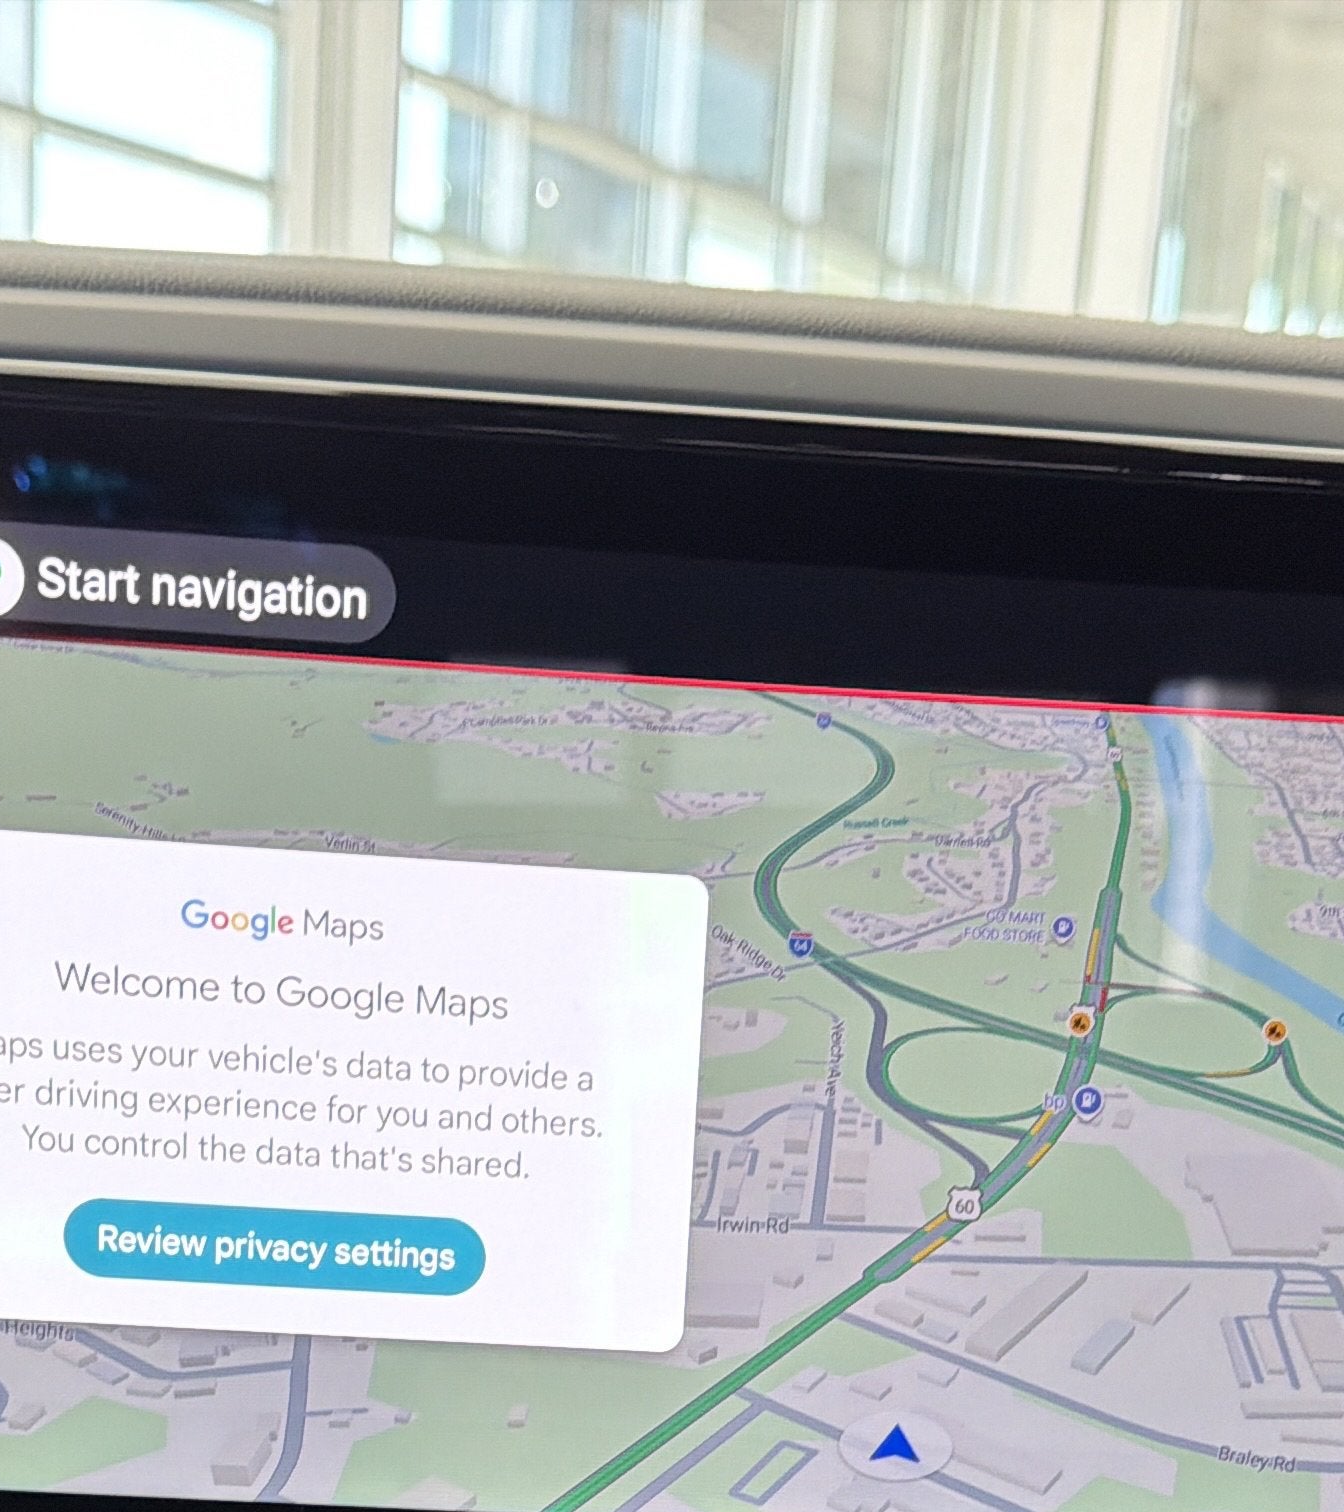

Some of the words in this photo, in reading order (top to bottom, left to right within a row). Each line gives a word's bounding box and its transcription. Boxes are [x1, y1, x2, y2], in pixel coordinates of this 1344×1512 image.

[37, 556, 140, 604] Start
[151, 571, 369, 622] navigation
[94, 802, 139, 833] Serenity
[141, 823, 167, 841] Hills
[181, 898, 294, 942] Google
[304, 908, 384, 947] Maps
[986, 909, 1006, 924] GO
[1008, 910, 1047, 925] MART
[1318, 905, 1341, 919] 9th
[793, 939, 809, 953] 64
[964, 927, 999, 941] FOOD
[1002, 928, 1046, 944] STORE
[711, 924, 735, 944] Oak
[737, 938, 772, 968] Ridge
[770, 965, 785, 982] Dr
[54, 960, 221, 1003] Welcome
[231, 974, 266, 1005] to
[276, 975, 405, 1021] Google
[416, 984, 509, 1026] Maps
[53, 1039, 123, 1064] uses
[131, 1043, 199, 1072] your
[208, 1043, 338, 1078] vehicle's
[346, 1050, 411, 1082] data
[421, 1057, 450, 1084] to
[458, 1060, 568, 1092] provide
[577, 1071, 594, 1092] a
[35, 1077, 139, 1119] driving
[148, 1089, 317, 1123] experience
[326, 1094, 368, 1125] for
[376, 1105, 429, 1133] you
[438, 1103, 493, 1132] and
[501, 1106, 603, 1139] others.
[1044, 1092, 1065, 1112] bp
[21, 1123, 75, 1153] You
[84, 1132, 189, 1160] control
[198, 1133, 247, 1164] the
[255, 1137, 321, 1168] data
[330, 1141, 413, 1174] that's
[421, 1145, 530, 1180] shared.
[954, 1197, 976, 1216] 60
[716, 1216, 762, 1234] Irwin
[764, 1216, 791, 1235] Rd
[97, 1223, 207, 1258] Review
[214, 1230, 328, 1271] privacy
[334, 1237, 456, 1277] settings
[4, 1319, 74, 1341] Heights
[1217, 1444, 1270, 1473] Braley
[1273, 1456, 1297, 1473] Rd
